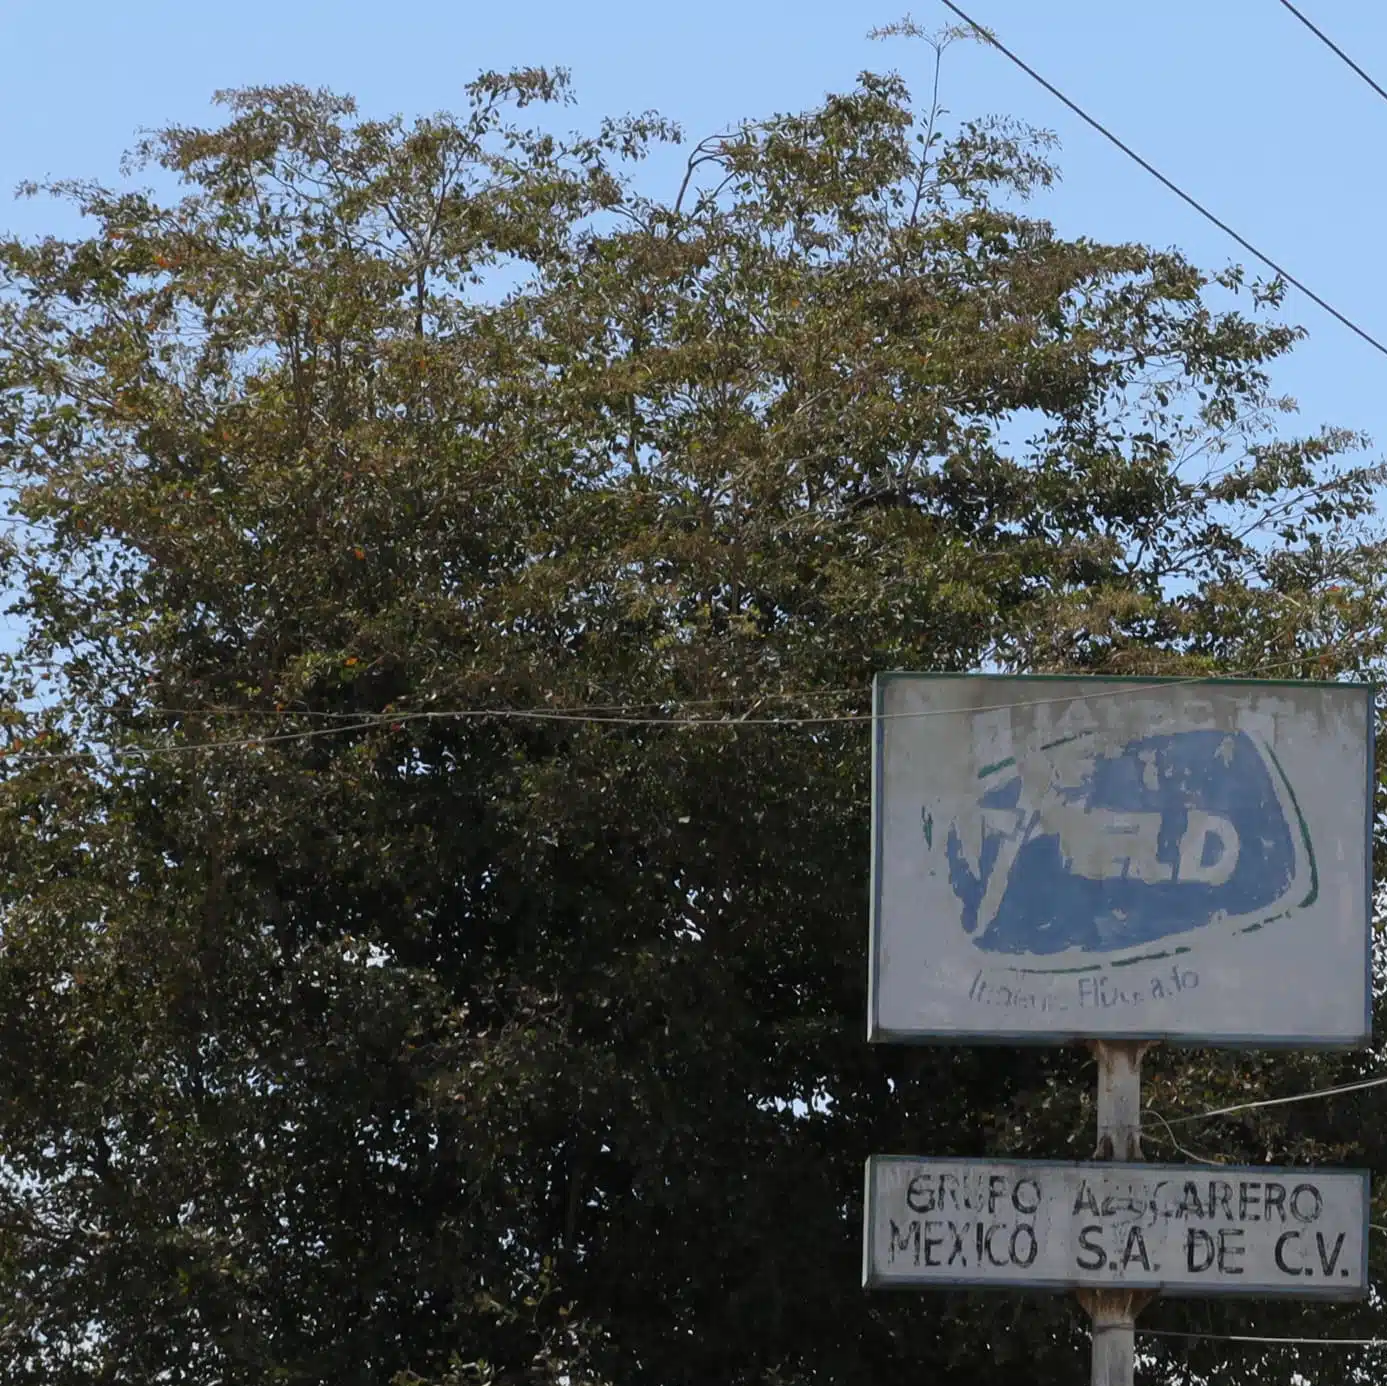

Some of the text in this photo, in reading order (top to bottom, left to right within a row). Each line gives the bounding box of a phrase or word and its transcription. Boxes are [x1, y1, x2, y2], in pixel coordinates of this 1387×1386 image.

[889, 1219, 1349, 1277] MEXICO S.A. DE C.V.
